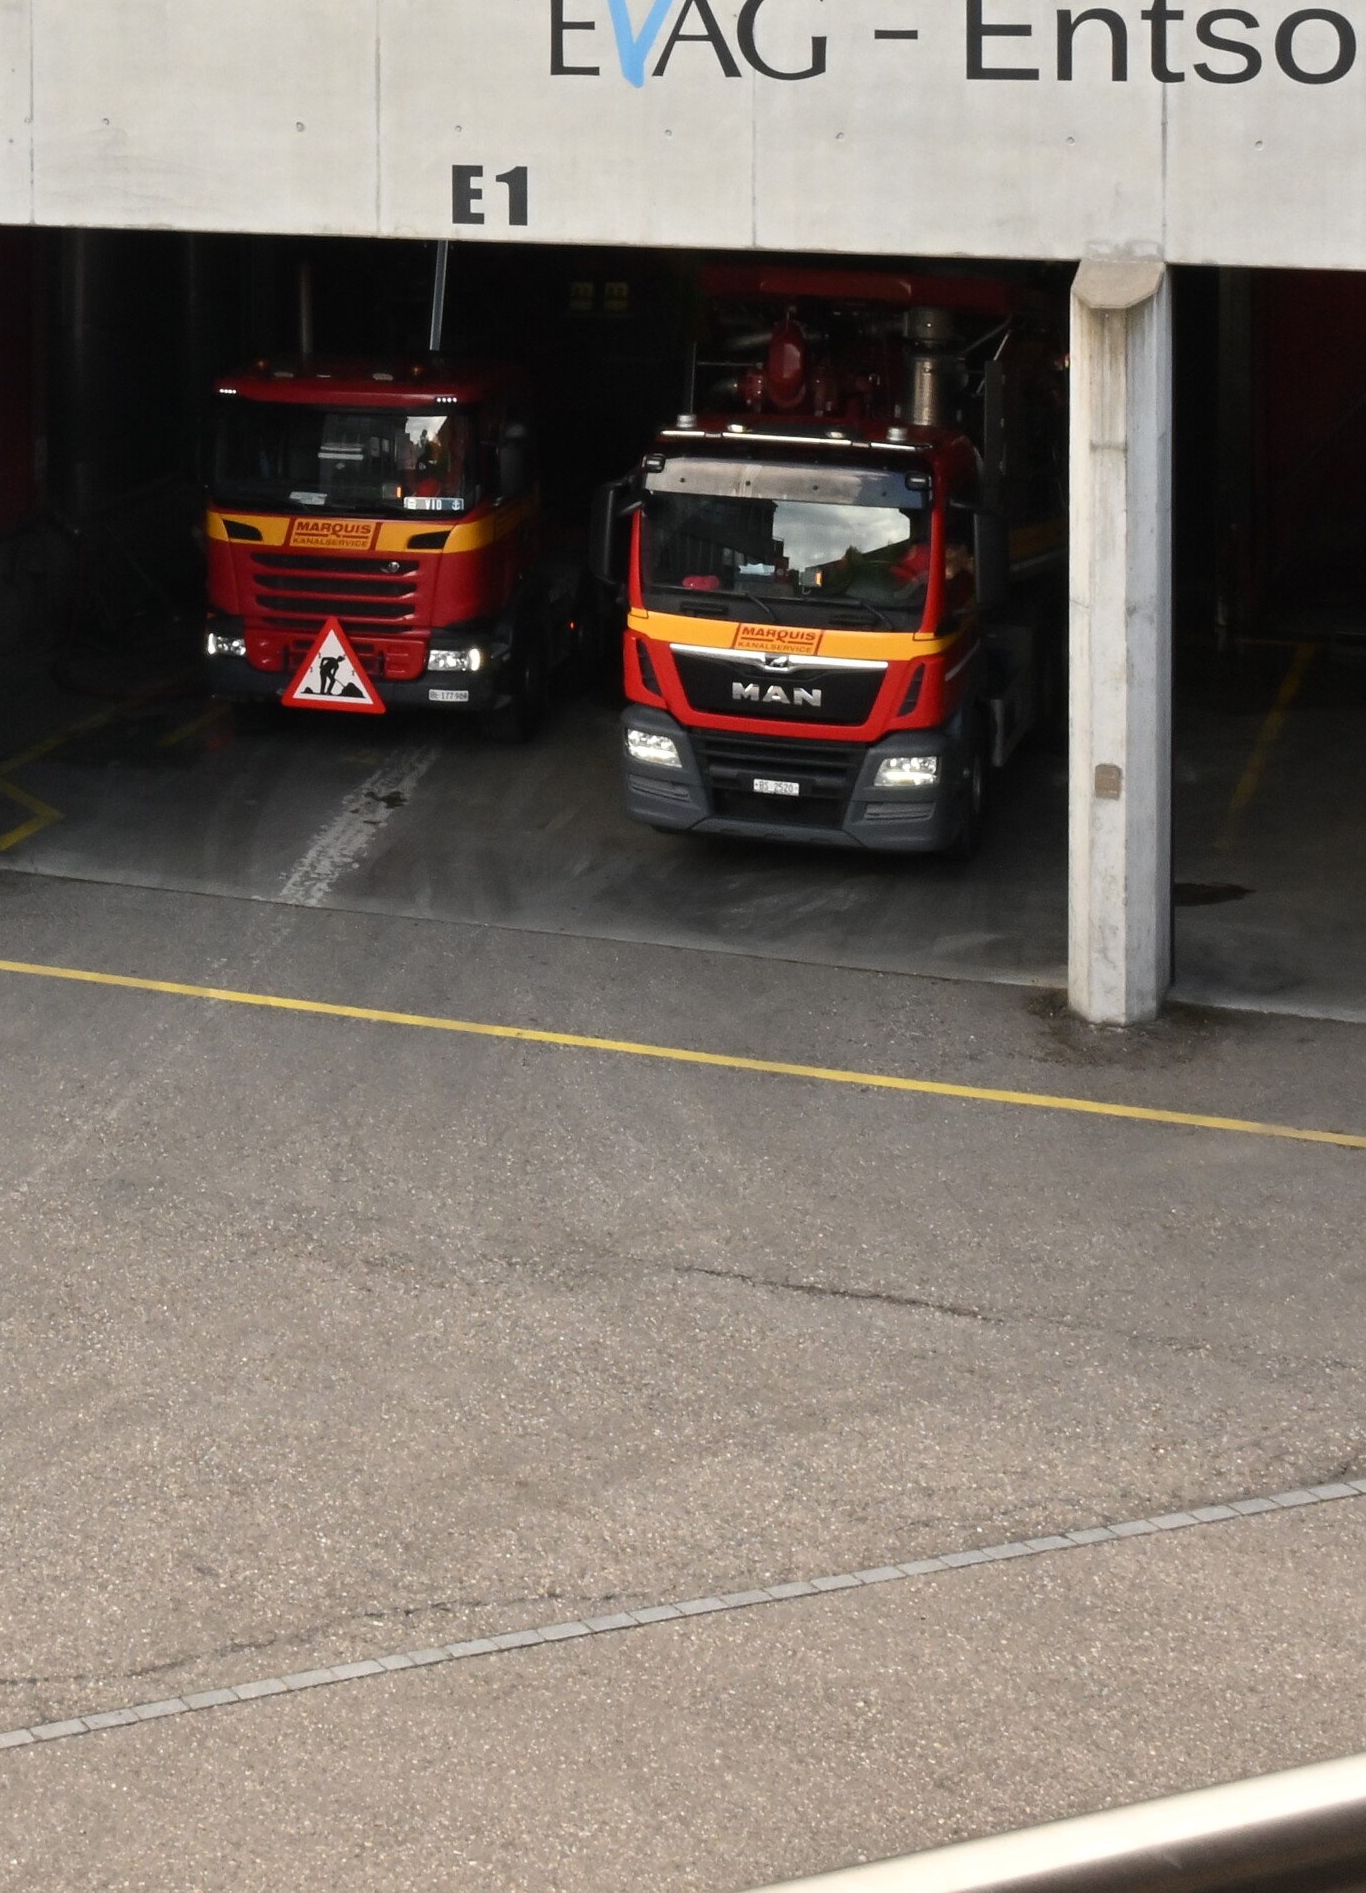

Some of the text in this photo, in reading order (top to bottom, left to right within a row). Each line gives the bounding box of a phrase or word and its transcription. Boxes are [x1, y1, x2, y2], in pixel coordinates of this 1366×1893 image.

[452, 165, 528, 226] E1
[295, 520, 372, 538] MARQUIS
[292, 536, 369, 548] KANALSERVICE
[742, 626, 816, 643] MARQUIS
[737, 641, 812, 653] KANALSERVICE
[732, 681, 822, 707] MAN
